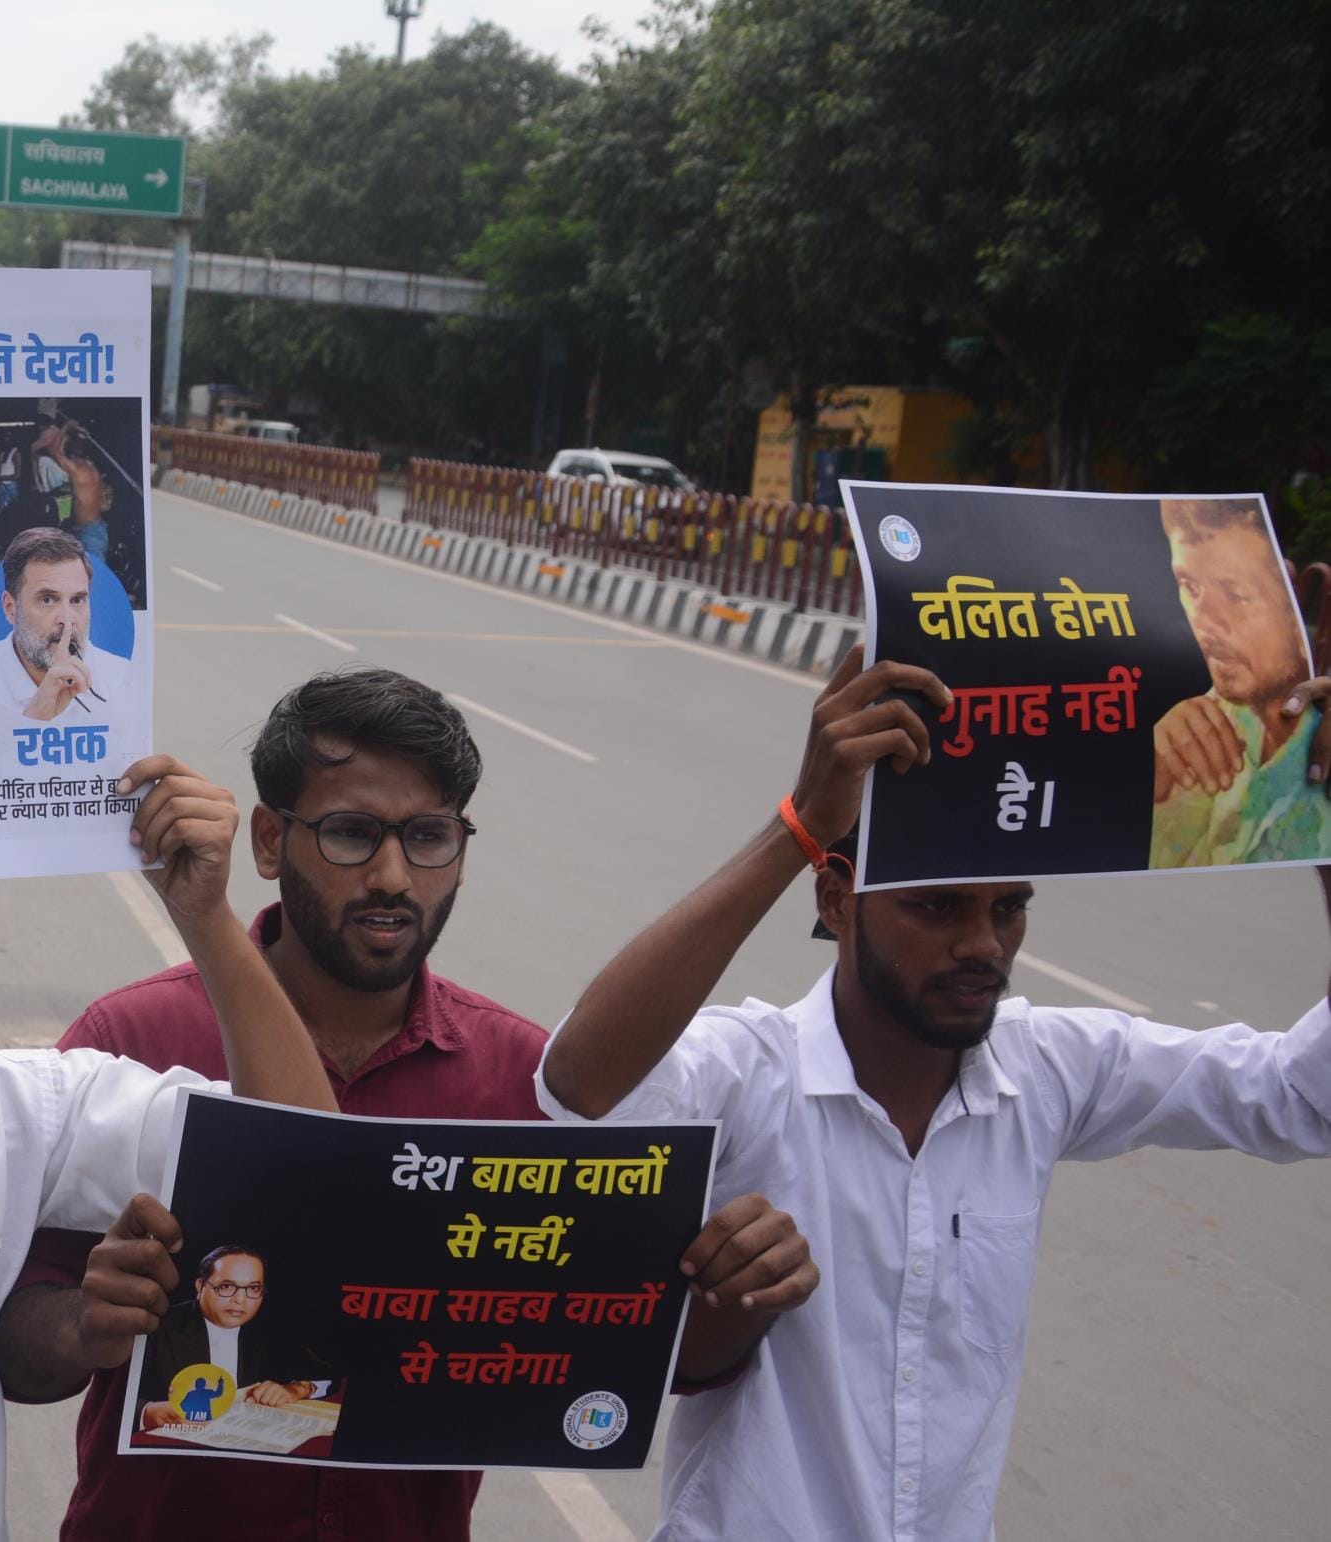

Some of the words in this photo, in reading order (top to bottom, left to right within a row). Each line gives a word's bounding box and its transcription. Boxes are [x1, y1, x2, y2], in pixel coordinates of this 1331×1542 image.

[23, 138, 105, 165] सचिवालय
[21, 177, 129, 200] SACHIVALAYA
[21, 333, 115, 384] देखी!
[912, 575, 1039, 640] दलित
[1043, 577, 1136, 639] होना
[939, 685, 1052, 757] गुनाह
[1061, 665, 1142, 733] नहीं
[13, 725, 109, 766] रक्षक
[38, 776, 87, 798] परिवार
[89, 774, 104, 795] से
[10, 803, 48, 819] न्याय
[51, 801, 70, 818] का
[73, 800, 101, 817] वादा
[391, 1142, 464, 1191] देश
[472, 1157, 568, 1194] बाबा
[575, 1145, 671, 1195] वालों
[446, 1213, 487, 1258] से
[493, 1215, 574, 1266] नहीं,
[340, 1284, 439, 1321] बाबा
[445, 1289, 558, 1325] साहब
[565, 1282, 667, 1325] वालों
[400, 1341, 439, 1384] से
[447, 1343, 572, 1385] चलेगा!
[195, 1411, 207, 1420] AM
[612, 1397, 625, 1418] UNION
[600, 1430, 619, 1445] INDIA
